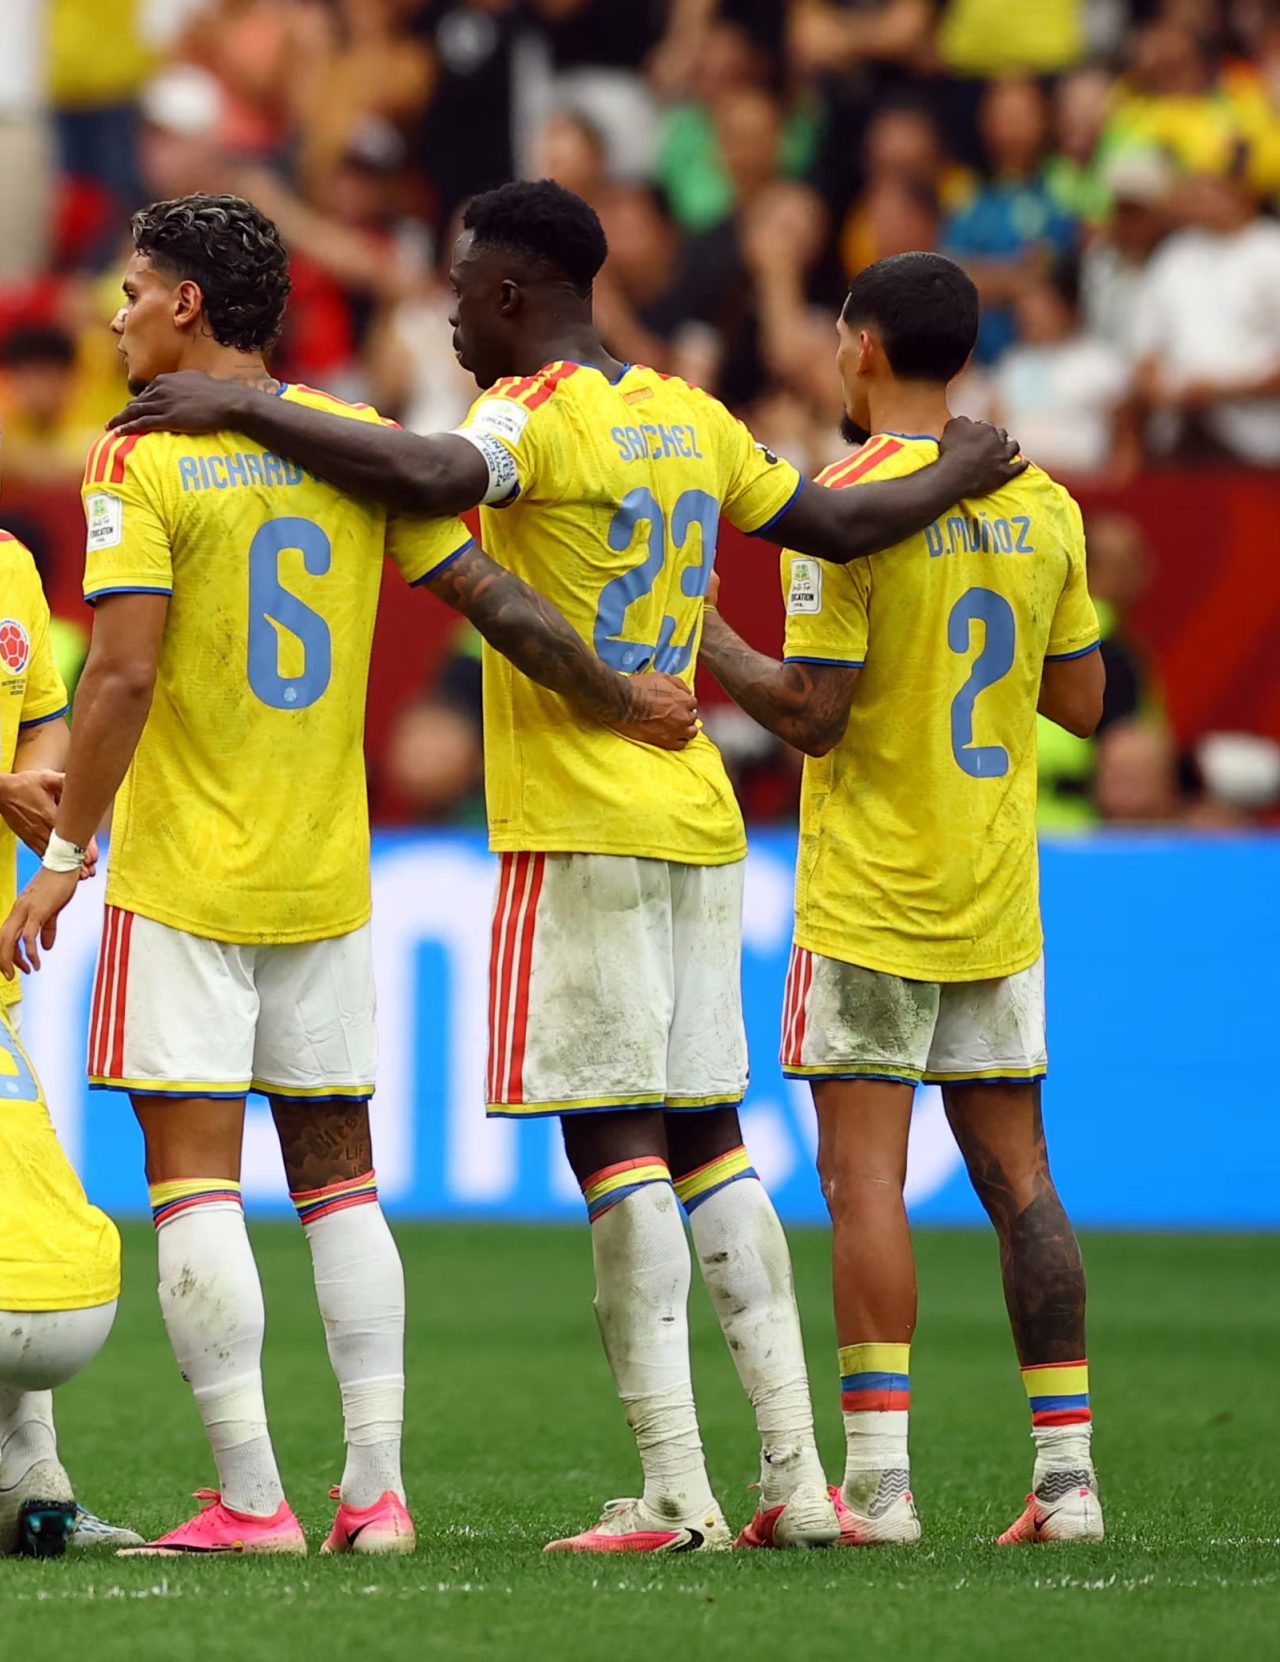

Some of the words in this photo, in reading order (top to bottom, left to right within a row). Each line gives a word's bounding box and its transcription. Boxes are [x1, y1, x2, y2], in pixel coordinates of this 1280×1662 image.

[247, 516, 332, 710] 6
[593, 486, 719, 675] 23
[948, 587, 1016, 779] 2
